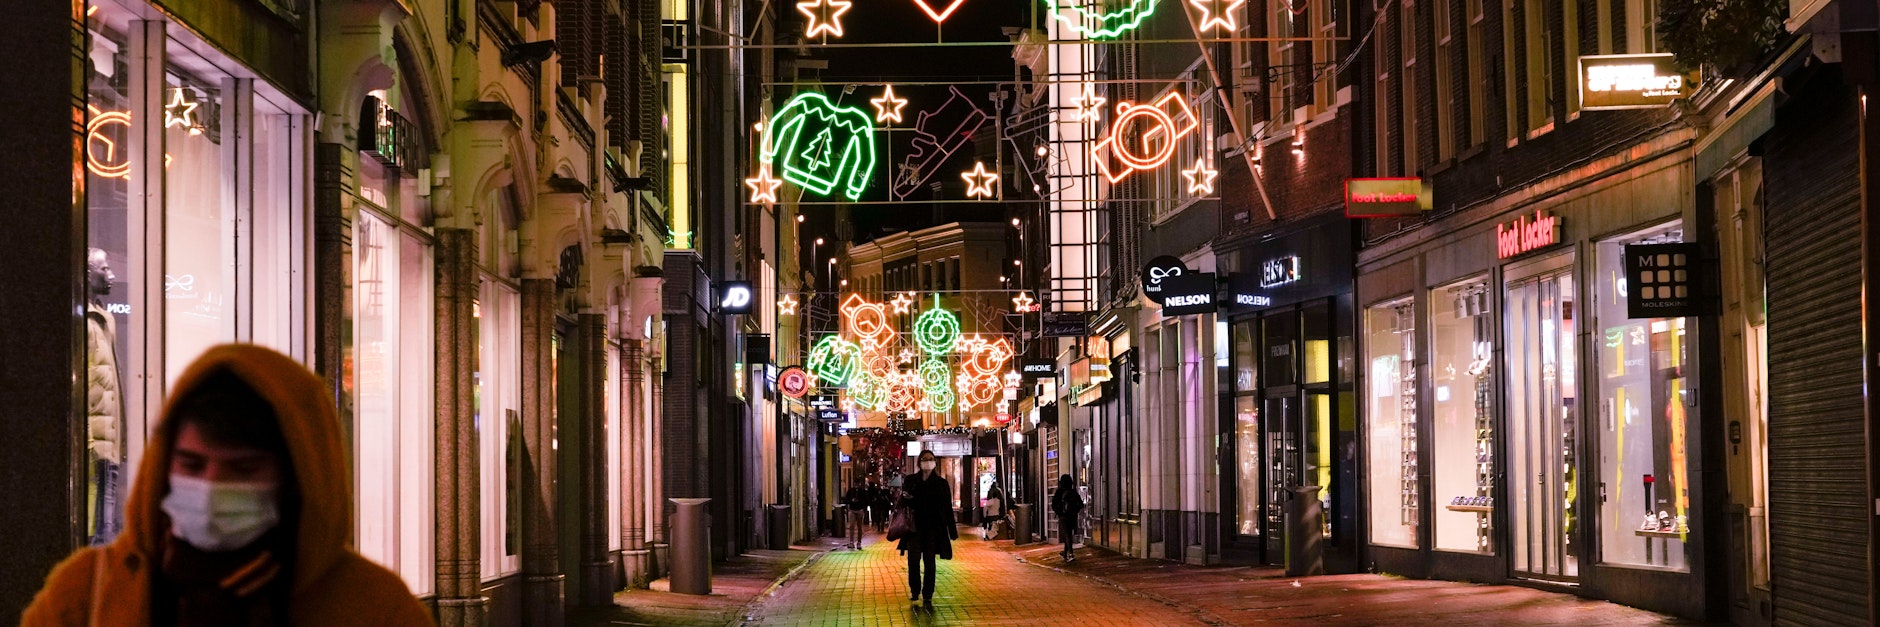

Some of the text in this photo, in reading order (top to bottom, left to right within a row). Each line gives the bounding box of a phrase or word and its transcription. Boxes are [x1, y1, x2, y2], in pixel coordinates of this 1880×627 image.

[1351, 192, 1417, 203] Foot Locker
[1497, 209, 1555, 259] Foot Locker
[1639, 255, 1654, 268] M
[721, 286, 750, 308] JD
[1165, 294, 1211, 307] NELSON
